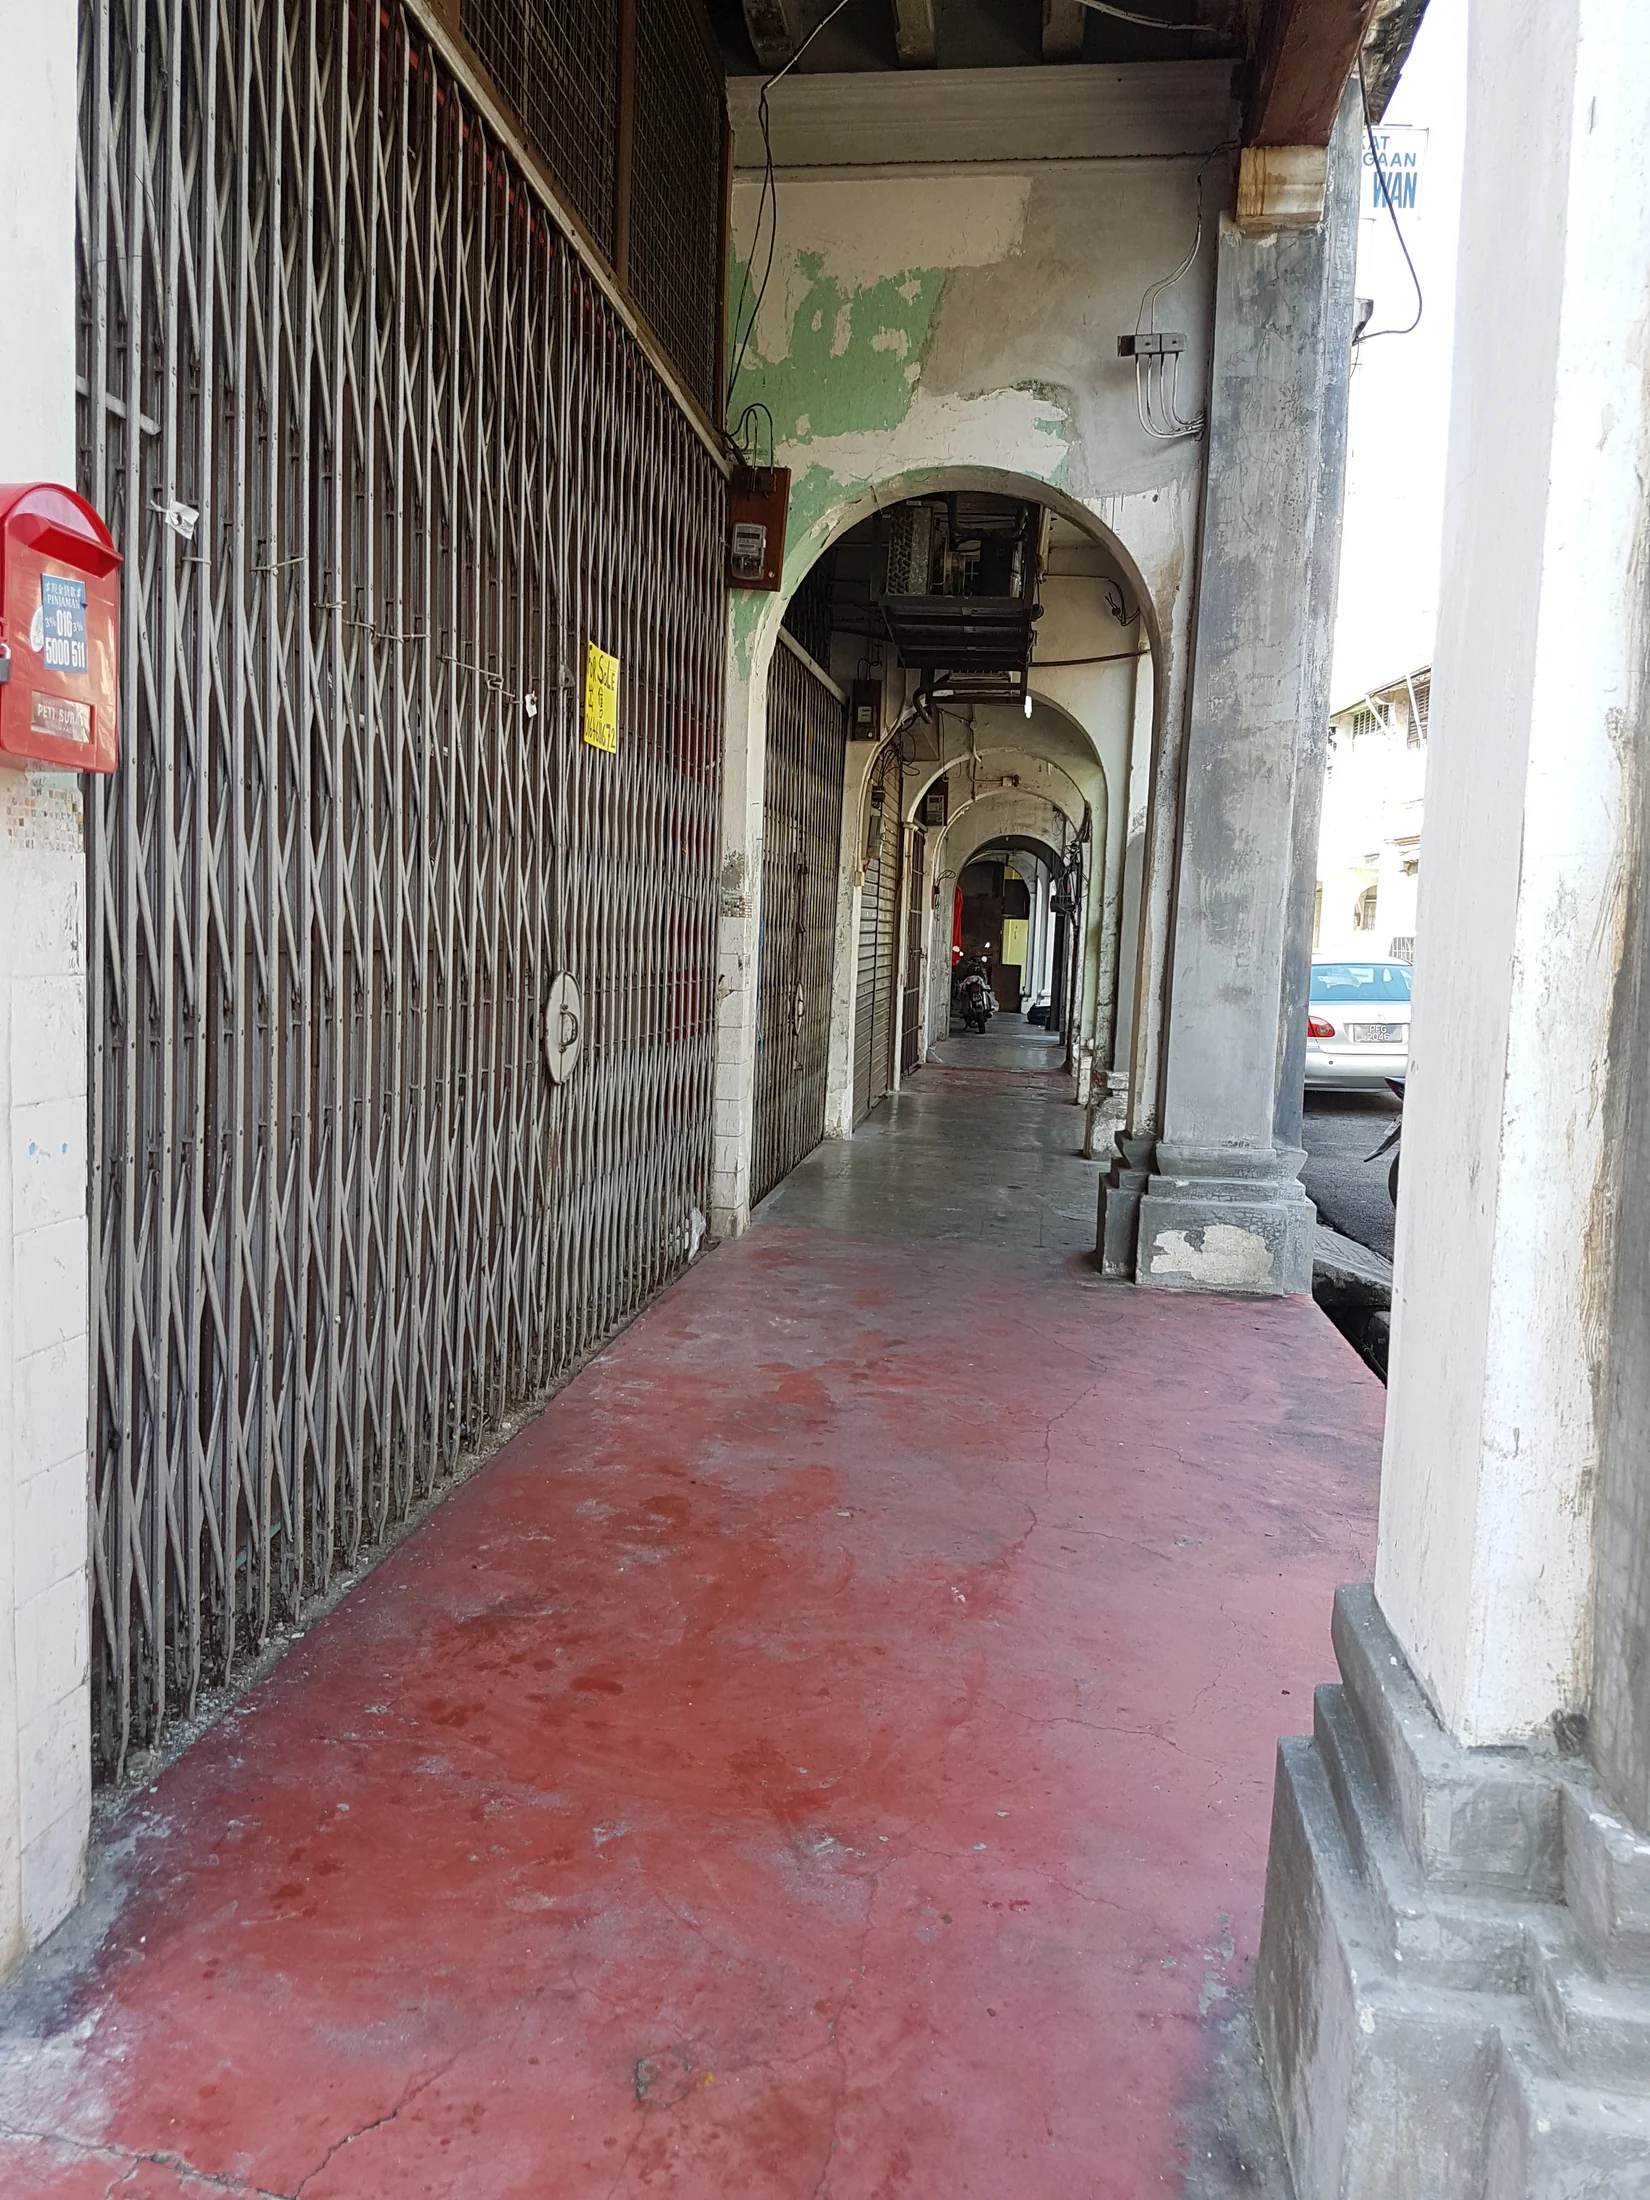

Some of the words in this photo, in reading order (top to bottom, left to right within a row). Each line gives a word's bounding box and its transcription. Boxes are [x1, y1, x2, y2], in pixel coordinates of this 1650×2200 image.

[1373, 172, 1418, 208] WAN
[47, 594, 80, 609] PINJAMAN
[45, 617, 56, 628] 3%
[56, 609, 72, 637] 016
[73, 622, 83, 633] 3%
[45, 637, 70, 666] 5000
[71, 641, 85, 668] 511
[38, 703, 55, 721] PETI
[1366, 1033, 1390, 1041] 2046
